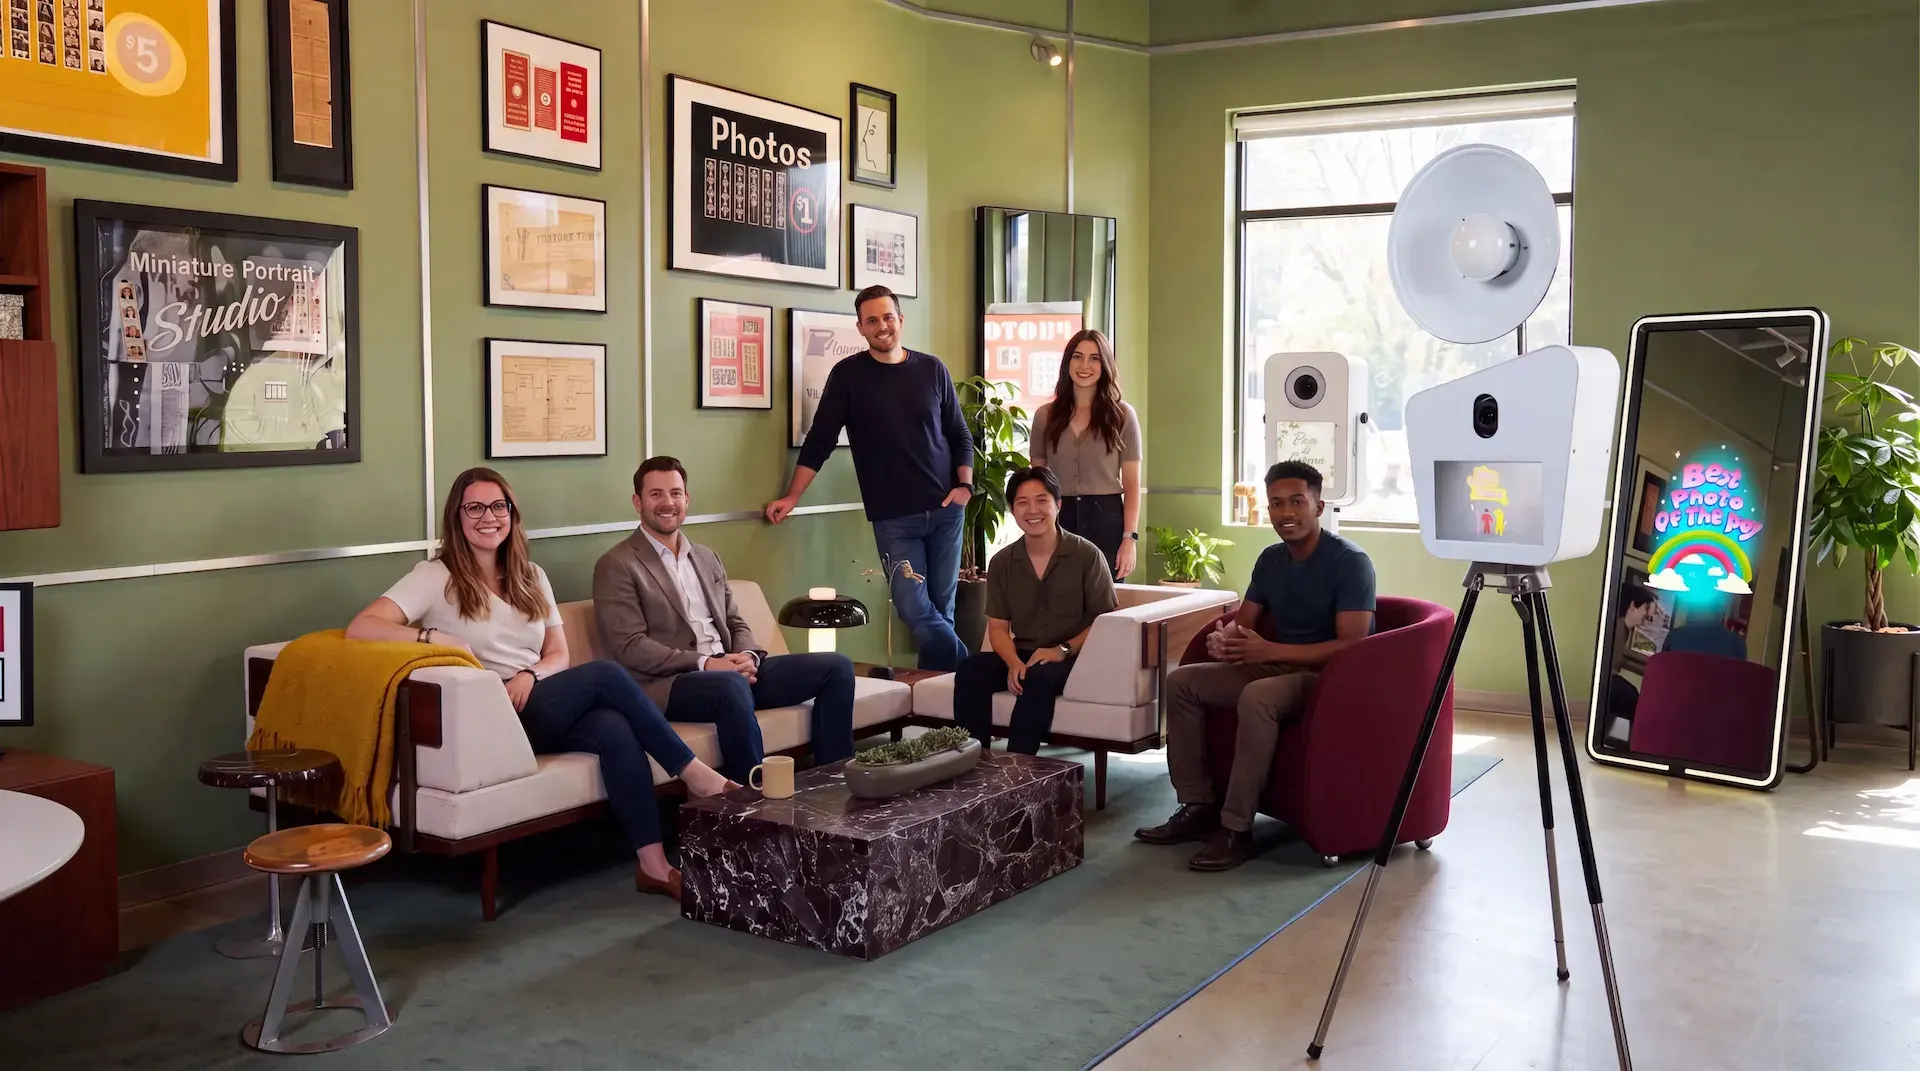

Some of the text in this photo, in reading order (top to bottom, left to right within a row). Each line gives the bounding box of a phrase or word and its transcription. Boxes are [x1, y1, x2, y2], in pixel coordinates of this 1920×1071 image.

[126, 34, 159, 74] $5
[711, 115, 812, 170] Photos
[796, 195, 813, 225] $1
[130, 251, 316, 283] Miniature Portrait
[148, 284, 286, 352] Studio
[1681, 462, 1742, 490] Best
[1670, 488, 1744, 511] Photo
